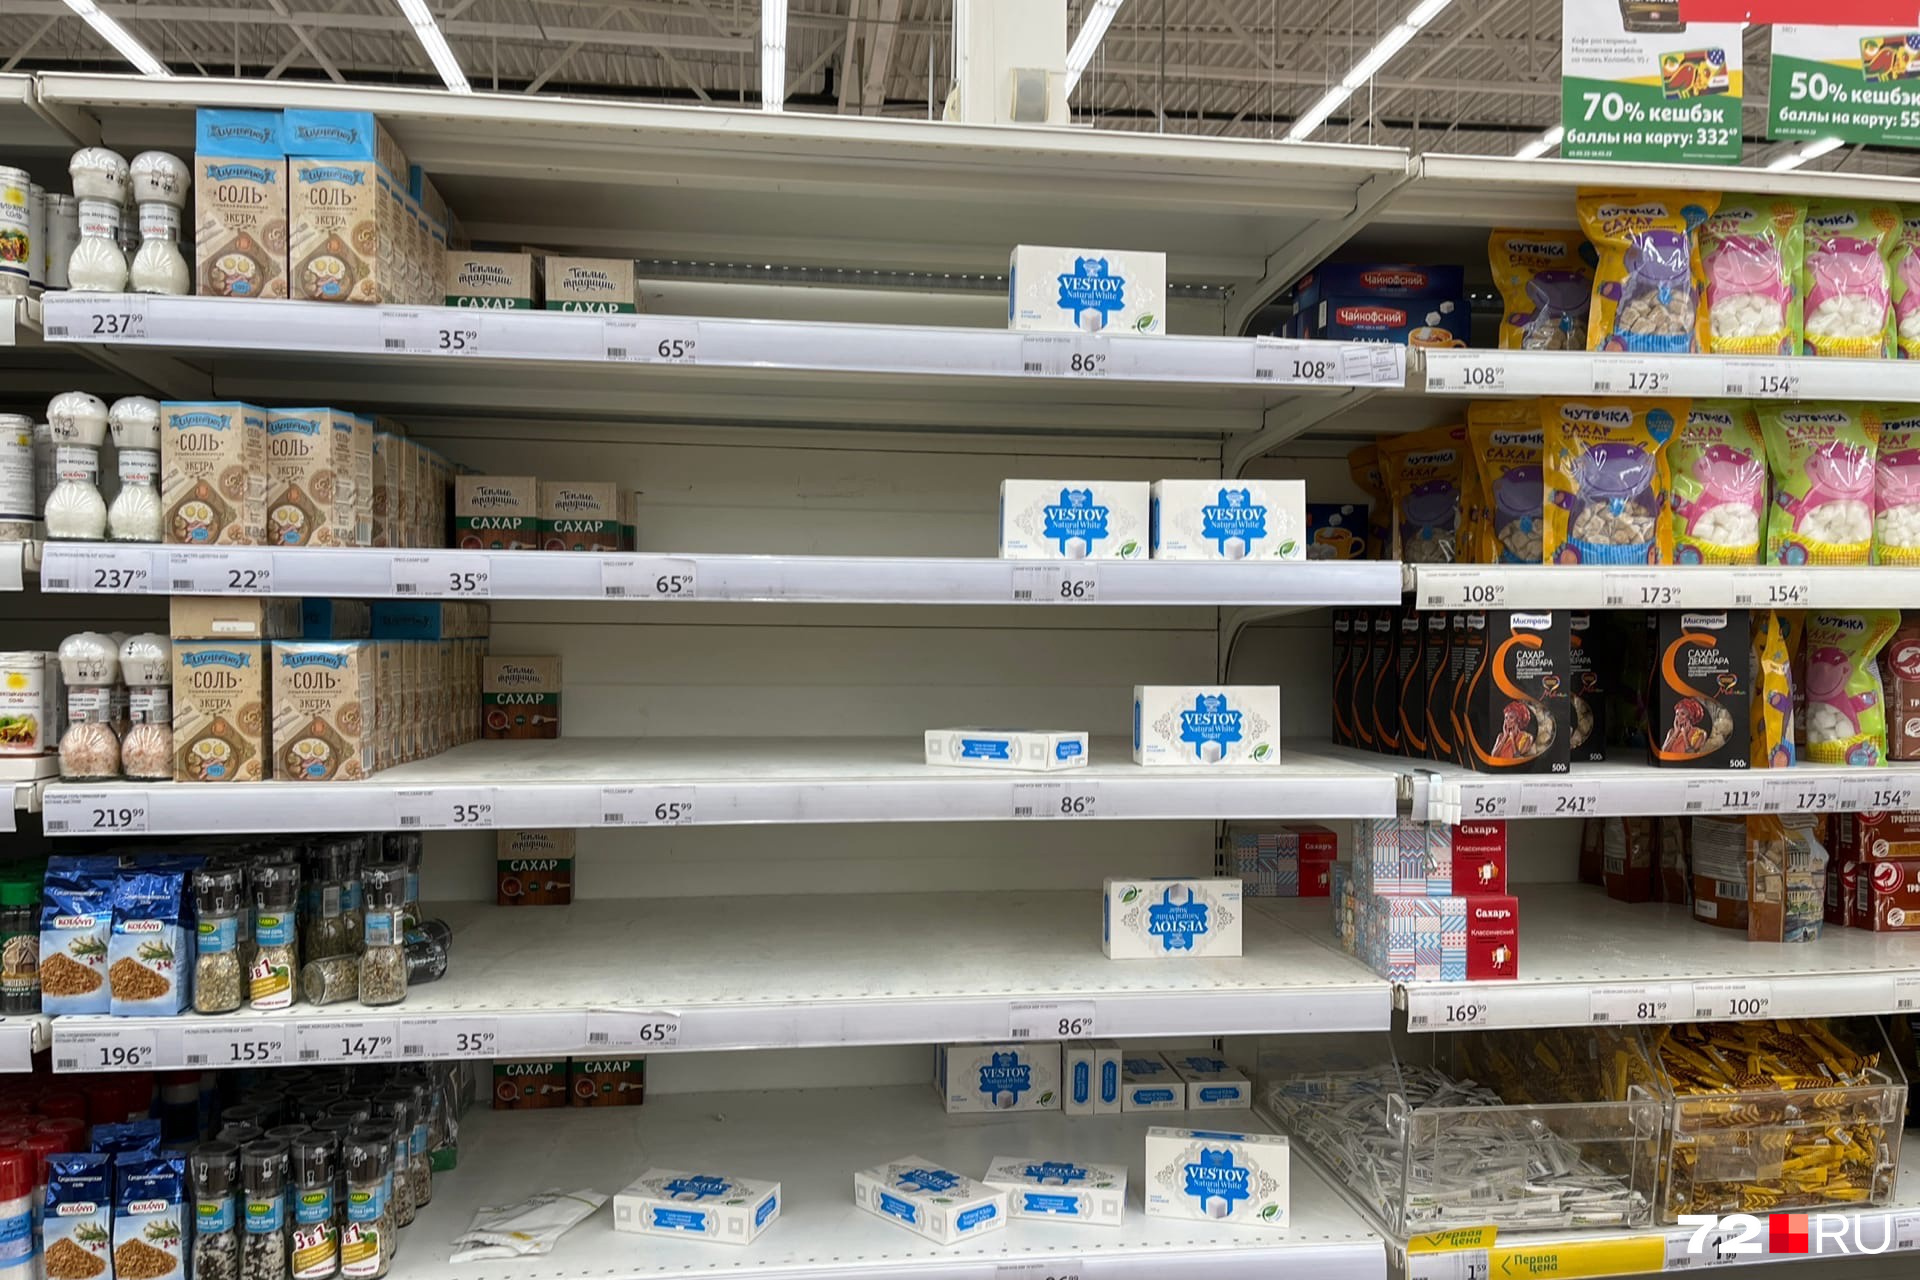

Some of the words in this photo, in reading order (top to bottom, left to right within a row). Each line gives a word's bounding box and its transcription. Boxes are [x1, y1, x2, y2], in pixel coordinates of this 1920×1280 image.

[1790, 71, 1848, 103] 50%
[1583, 92, 1645, 123] 70%
[1649, 102, 1724, 124] кешбэк
[1779, 106, 1829, 123] баллы
[1832, 113, 1850, 124] на
[1852, 113, 1897, 130] карту:
[1567, 127, 1620, 145] баллы
[1623, 133, 1642, 145] на
[1646, 132, 1693, 149] карту:
[218, 185, 263, 203] СОЛЬ
[309, 187, 352, 205] СОЛЬ
[223, 211, 257, 225] ЭКСТРА
[314, 213, 346, 226] ЭКСТРА
[1063, 277, 1121, 291] VESTOV
[1067, 290, 1096, 300] Natural
[1096, 291, 1117, 300] White
[1561, 422, 1611, 437] САХАР
[1785, 426, 1836, 439] САХАР
[180, 434, 220, 451] СОЛЬ
[272, 440, 309, 456] СОЛЬ
[1486, 448, 1536, 460] САХАР
[185, 461, 214, 473] ЭКСТРА
[277, 466, 305, 477] ЭКСТРА
[1048, 507, 1105, 521] VESTOV
[1206, 507, 1263, 521] VESTOV
[470, 517, 522, 530] САХАР
[553, 520, 603, 533] САХАР
[1052, 520, 1079, 530] Natural
[1079, 520, 1101, 530] White
[1211, 520, 1237, 530] Natural
[1237, 520, 1259, 530] White
[1065, 527, 1087, 537] Sugar
[1224, 527, 1246, 537] Sugar
[1512, 617, 1550, 627] Мистраль
[1683, 616, 1725, 626] Мистраль
[1516, 650, 1545, 660] САХАР
[1687, 648, 1720, 659] САХАР
[1516, 658, 1554, 668] ДЕМЕРАРА
[1687, 656, 1730, 666] ДЕМЕРАРА
[194, 671, 238, 689] СОЛЬ
[293, 672, 336, 689] СОЛЬ
[199, 698, 232, 710] ЭКСТРА
[300, 698, 331, 709] ЭКСТРА
[496, 693, 545, 706] САХАР
[1184, 712, 1239, 726] VESTOV
[1188, 725, 1214, 734] Natural
[1214, 725, 1235, 734] White
[1201, 732, 1221, 741] Sugar
[1461, 825, 1498, 835] Сахаръ
[1456, 845, 1502, 853] Классический
[510, 859, 558, 872] САХАР
[1475, 908, 1511, 919] Сахаръ
[1152, 920, 1203, 933] VESTOV
[1470, 928, 1515, 937] Классический
[506, 1063, 553, 1077] САХАР
[584, 1061, 631, 1074] САХАР
[983, 1067, 1029, 1079] VESTOV
[1189, 1166, 1246, 1183] VESTOV
[1193, 1180, 1221, 1190] Natural
[1221, 1182, 1242, 1191] White
[1206, 1187, 1227, 1197] Sugar
[295, 1232, 304, 1249] 3
[1514, 1254, 1558, 1265] Первая
[1529, 1262, 1559, 1274] цена
